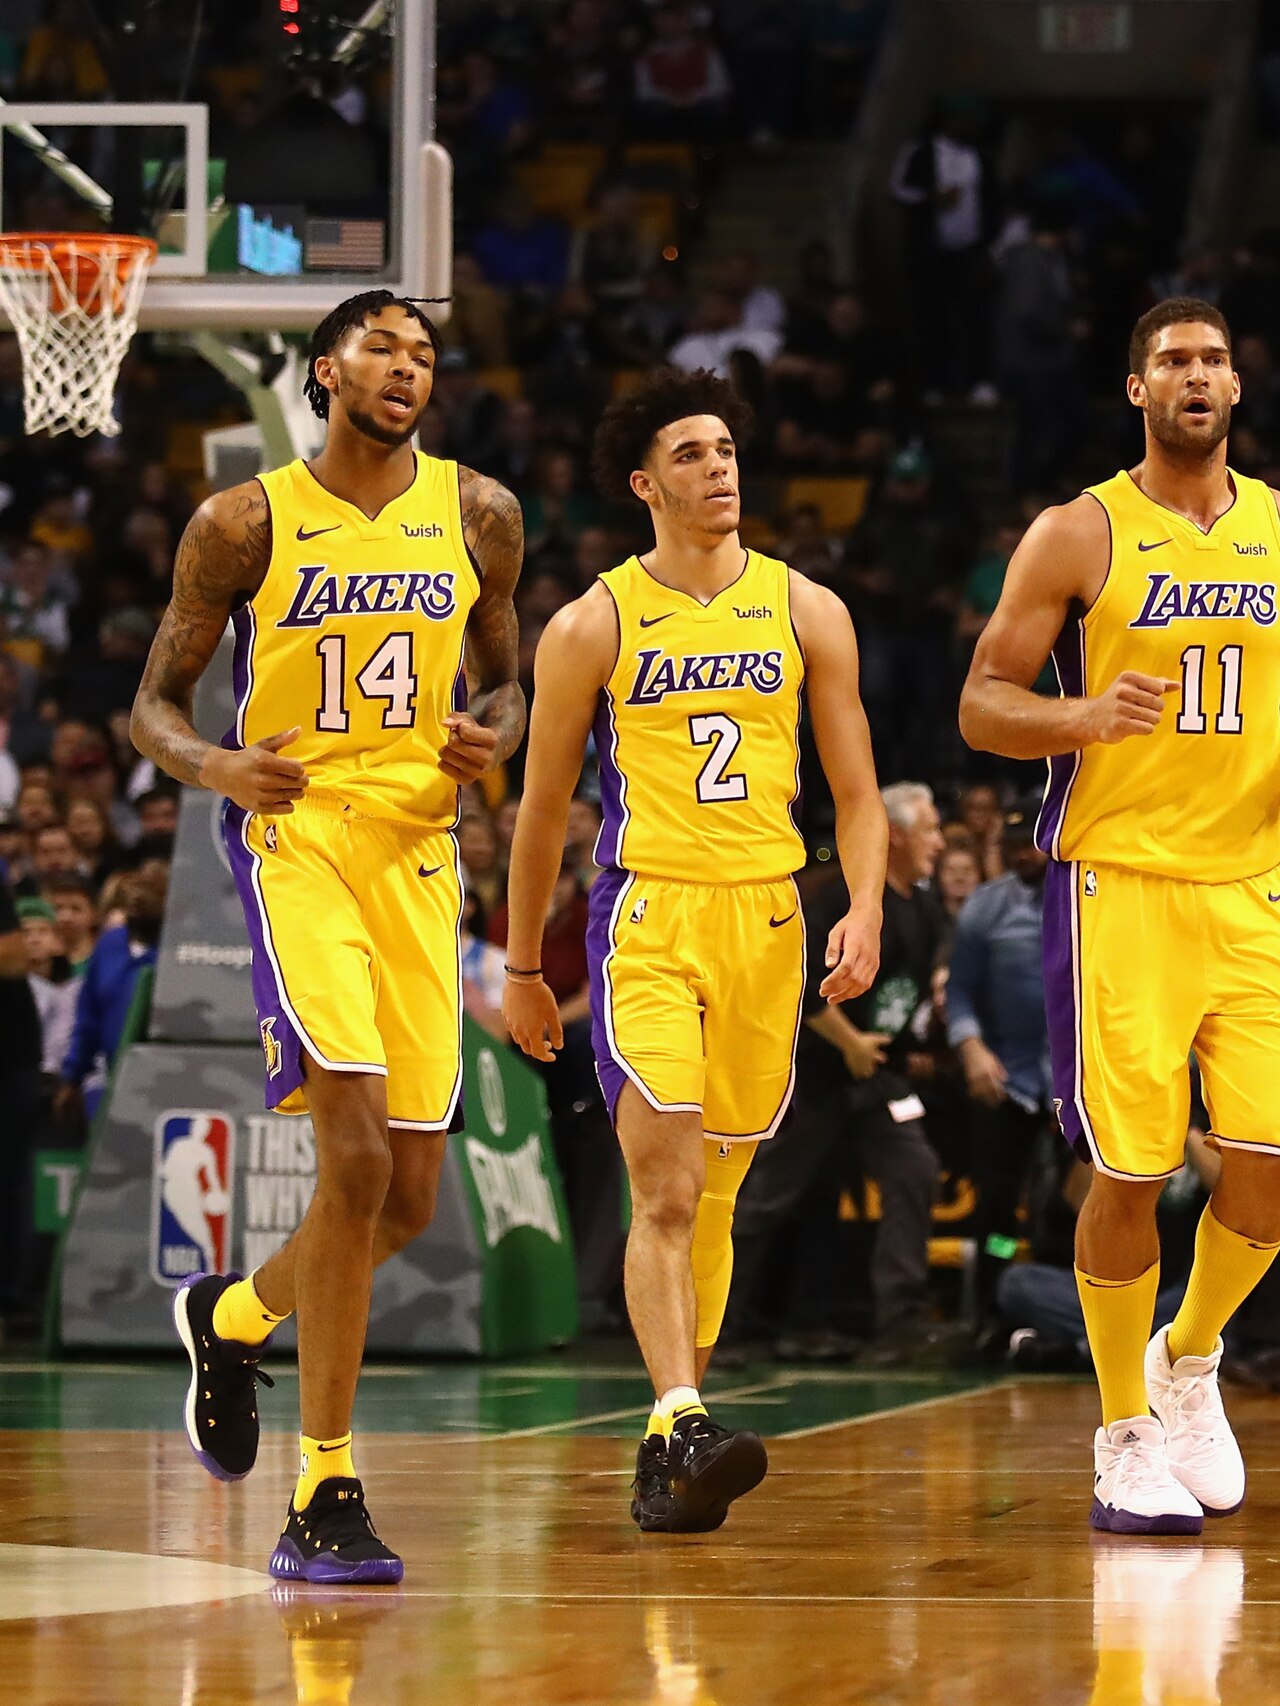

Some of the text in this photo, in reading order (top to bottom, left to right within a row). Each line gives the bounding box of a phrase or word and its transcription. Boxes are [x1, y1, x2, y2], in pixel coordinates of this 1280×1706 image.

[400, 523, 443, 538] wish
[1233, 542, 1267, 556] wish
[277, 564, 458, 629] LAKERS
[732, 606, 773, 620] wish
[1128, 572, 1278, 629] LAKERS
[316, 631, 418, 734] 14
[624, 647, 784, 706] LAKERS
[1176, 644, 1244, 735] 11
[688, 712, 748, 804] 2
